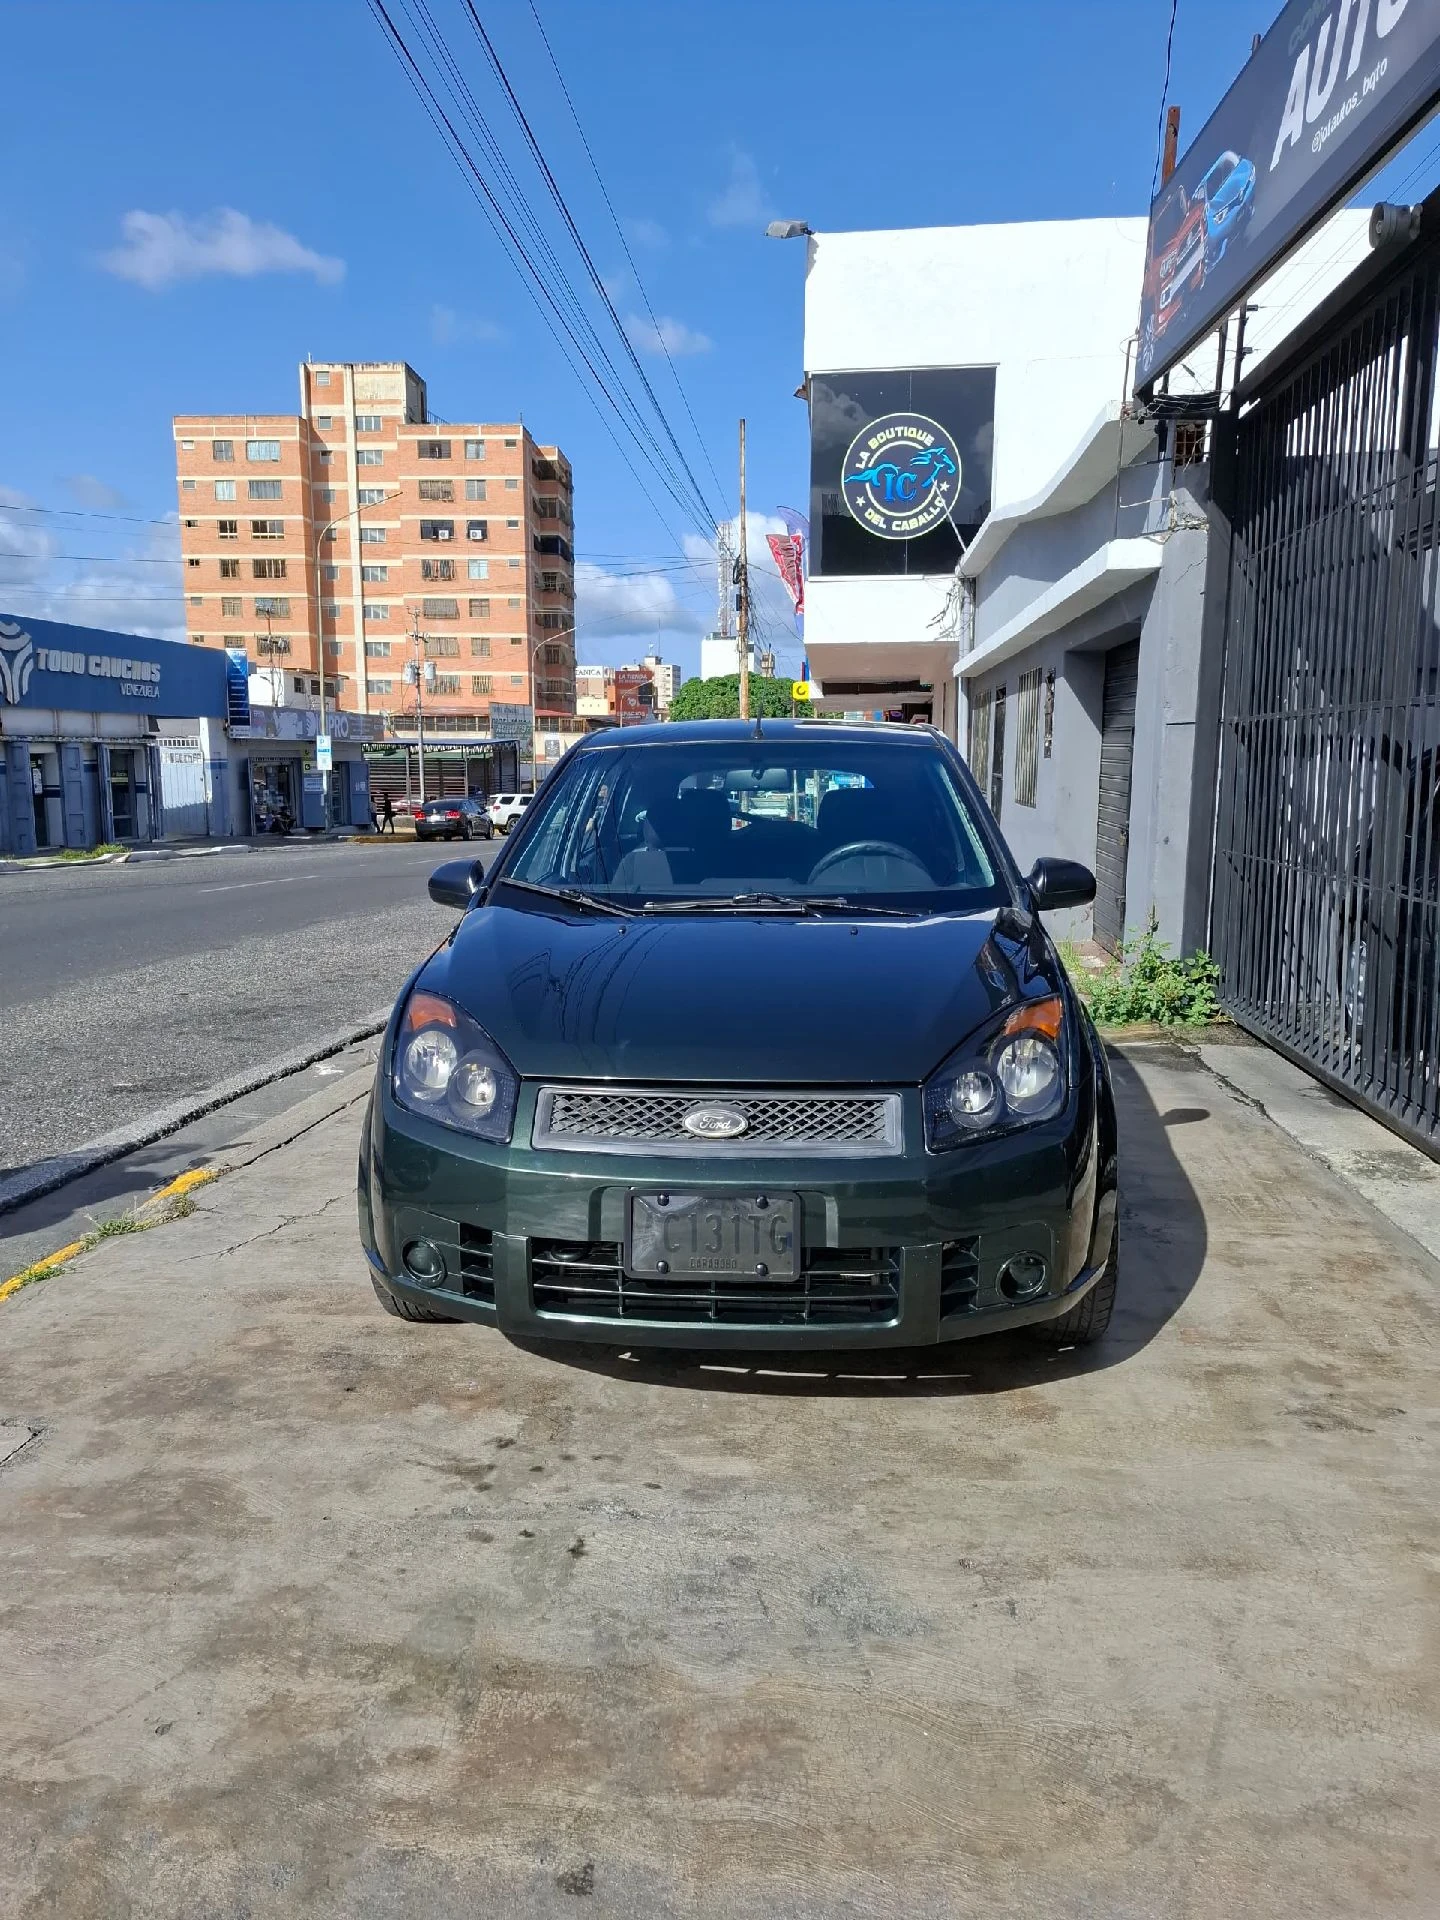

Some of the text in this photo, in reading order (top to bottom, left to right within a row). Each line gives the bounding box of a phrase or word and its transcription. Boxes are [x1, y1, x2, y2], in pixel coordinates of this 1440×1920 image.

[855, 426, 935, 470] LA BOUTIQUE
[864, 496, 945, 531] DEL CABALLO
[36, 647, 161, 683] TODO CAUCHOS
[120, 682, 160, 698] VENEZUELA
[699, 1115, 731, 1130] Ford
[643, 1212, 789, 1256] C131TG
